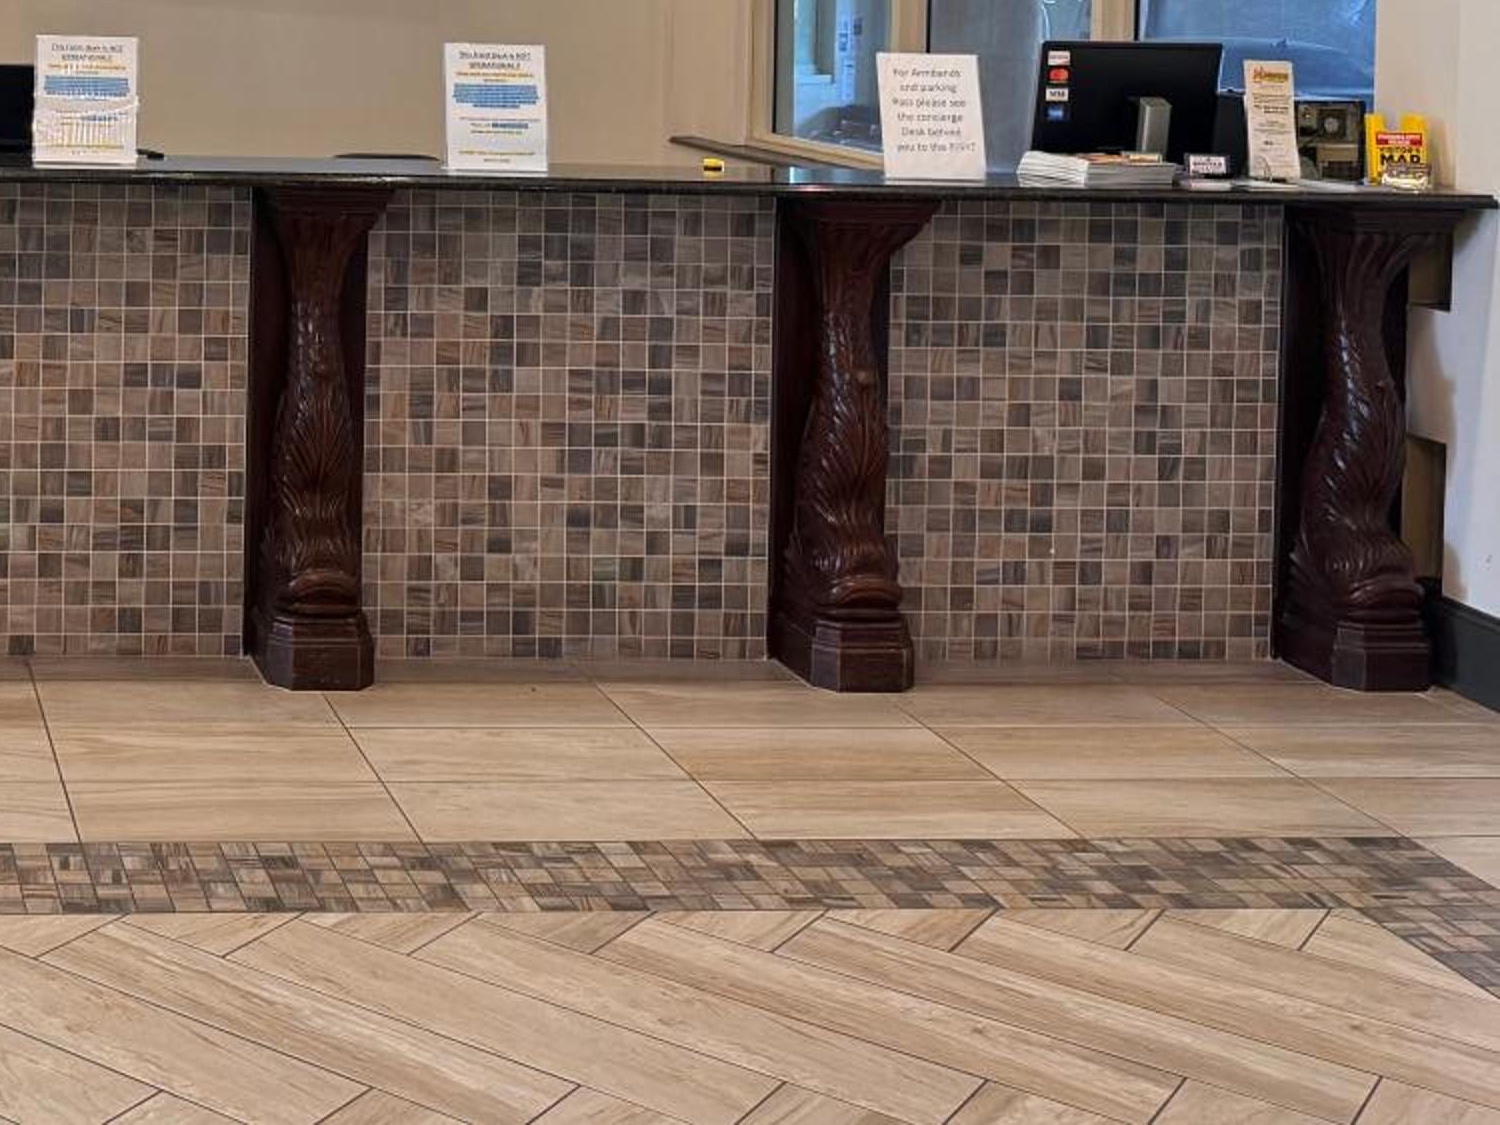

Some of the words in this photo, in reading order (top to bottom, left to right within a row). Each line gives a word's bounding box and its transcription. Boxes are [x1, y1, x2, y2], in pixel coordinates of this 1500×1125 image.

[920, 83, 957, 93] parking
[916, 98, 947, 108] please
[897, 112, 914, 121] the
[917, 113, 963, 123] concierge
[901, 127, 925, 135] Desk
[918, 142, 928, 151] to
